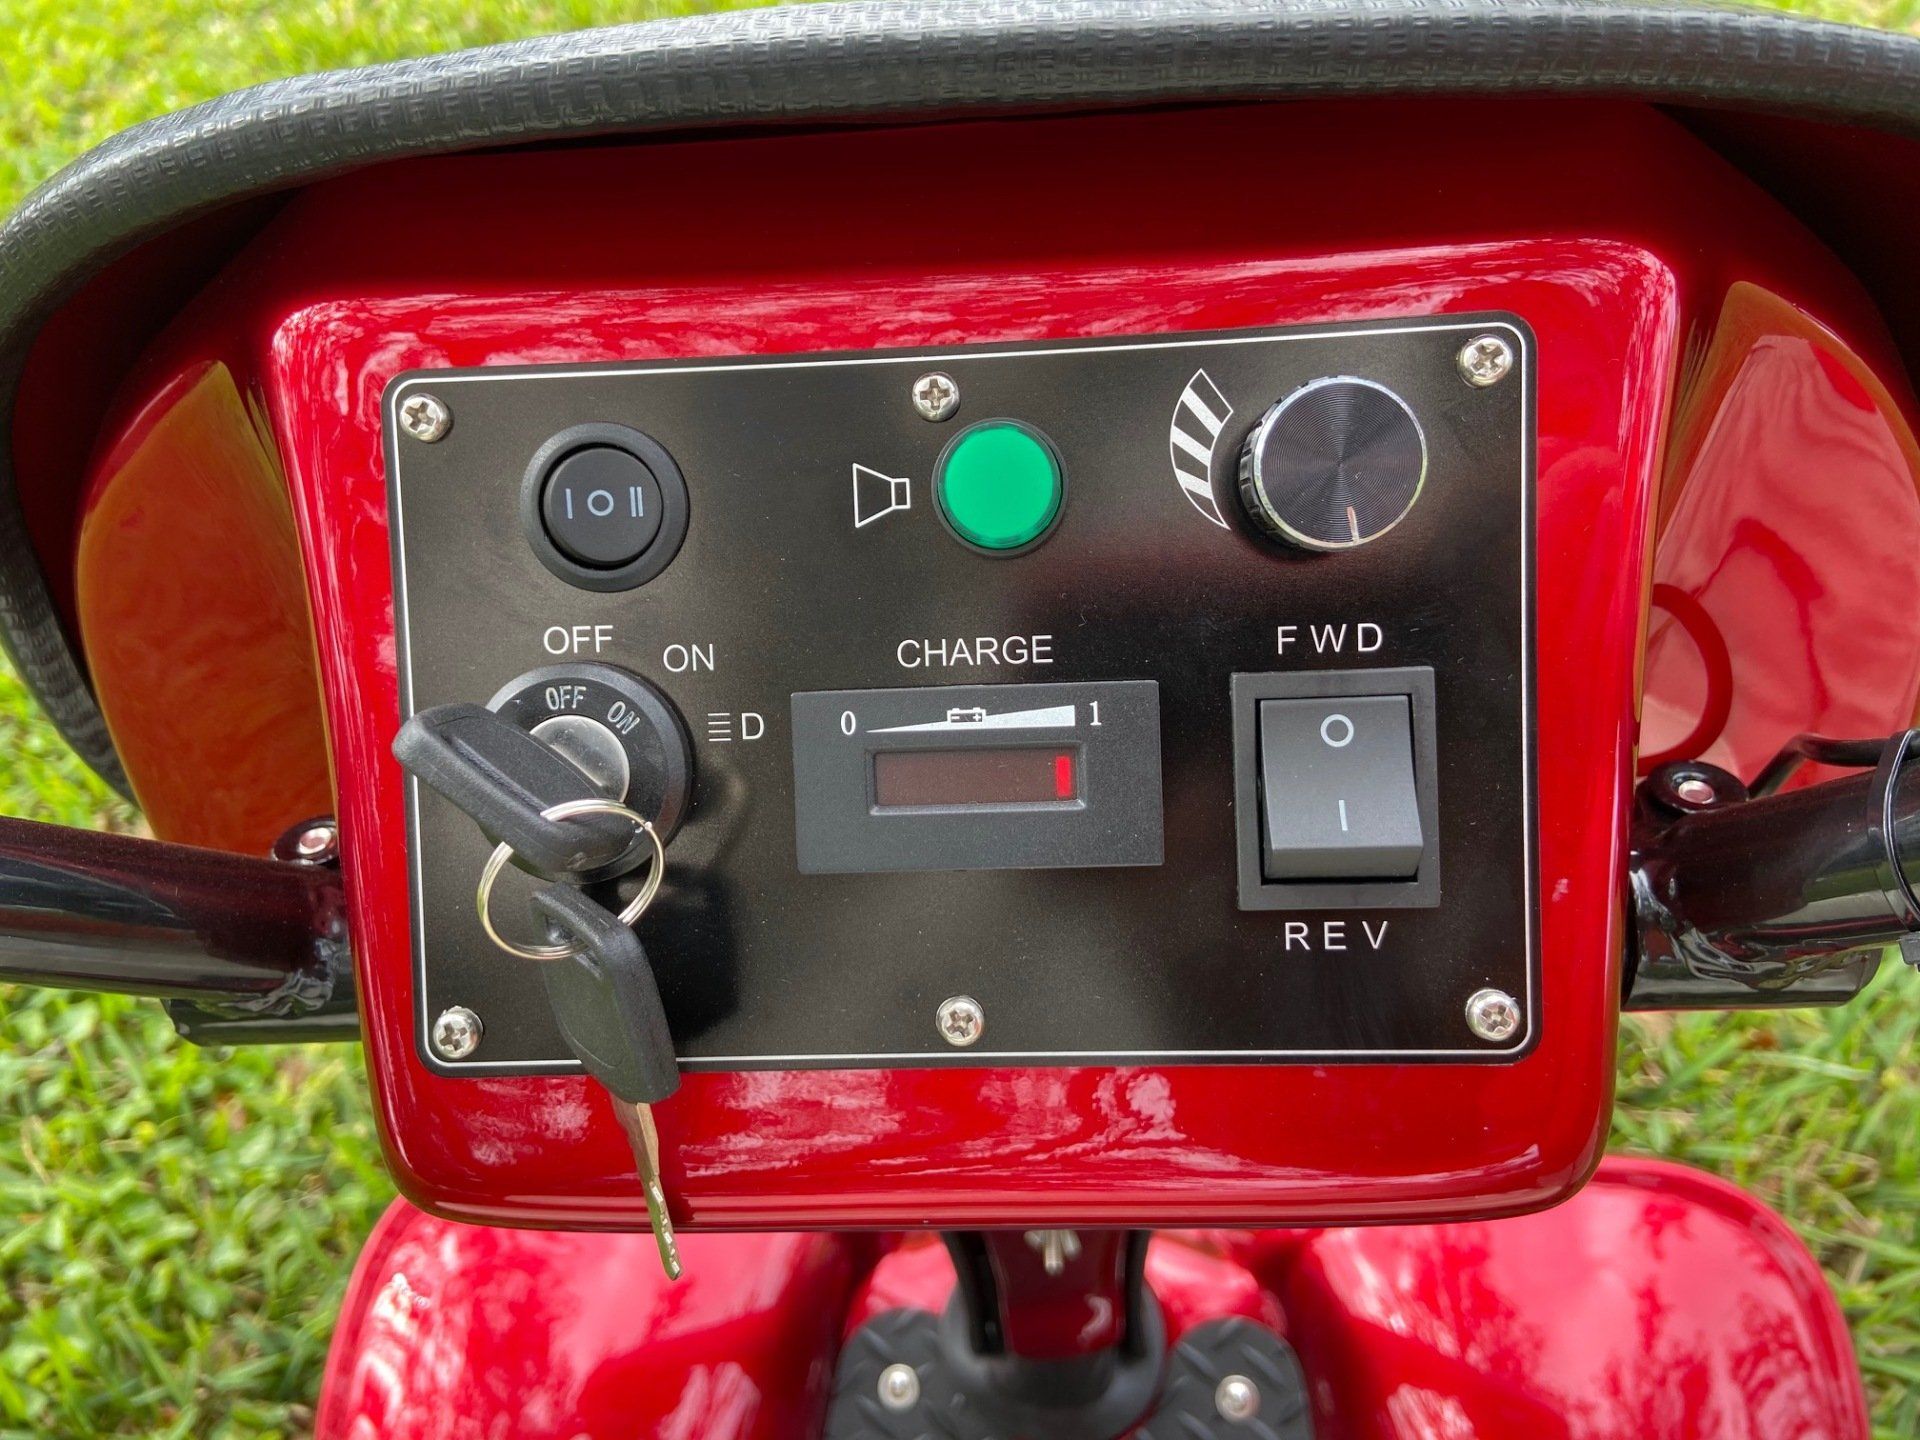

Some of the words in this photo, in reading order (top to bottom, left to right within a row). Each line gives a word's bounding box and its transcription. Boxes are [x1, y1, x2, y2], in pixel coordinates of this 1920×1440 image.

[543, 624, 614, 655] OFF
[896, 634, 1054, 668] CHARGE
[1277, 622, 1384, 655] FWD
[662, 643, 715, 673] ON
[545, 685, 587, 711] OFF
[1088, 700, 1102, 726] 1
[606, 700, 641, 735] ON
[1284, 920, 1389, 951] REV
